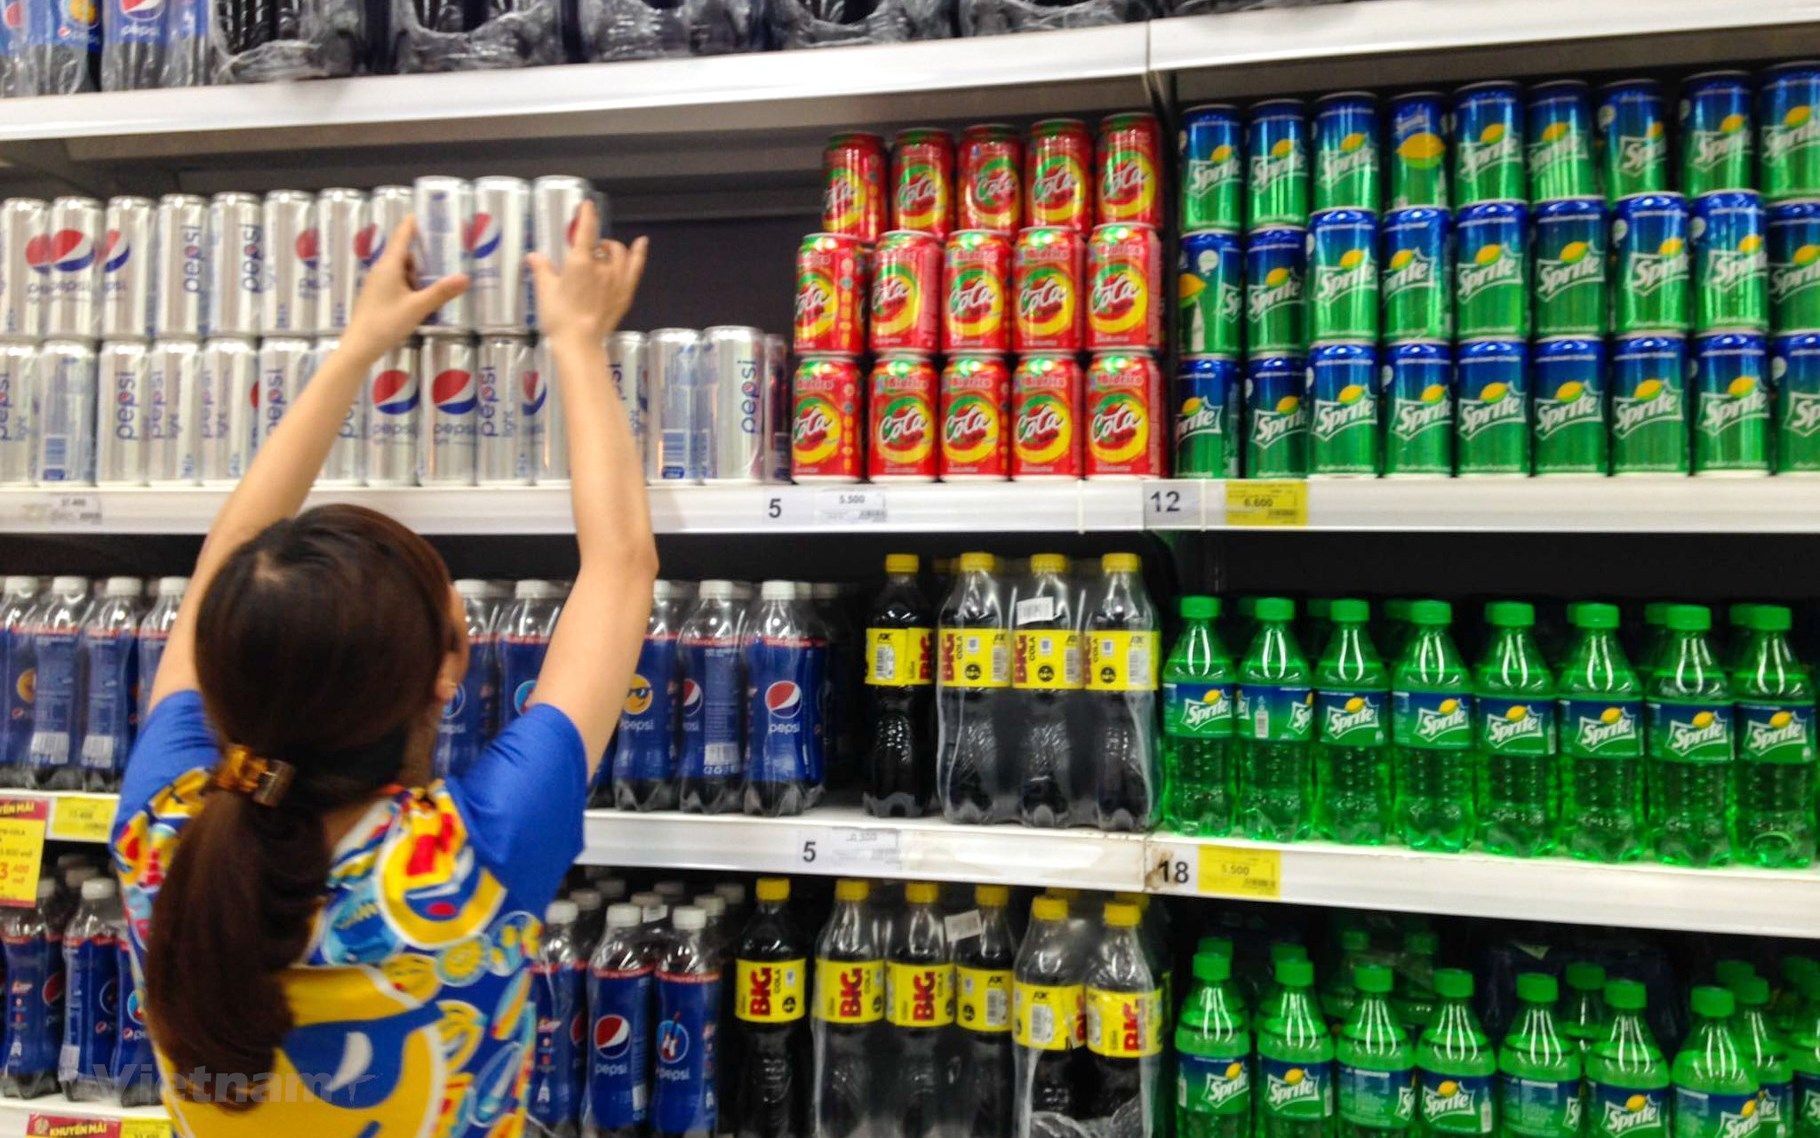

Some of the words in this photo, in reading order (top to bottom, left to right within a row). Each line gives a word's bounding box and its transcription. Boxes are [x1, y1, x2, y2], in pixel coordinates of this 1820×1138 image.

[1317, 264, 1374, 301] Sprite
[1457, 255, 1517, 297] Sprite
[1539, 254, 1601, 296] Sprite
[948, 278, 996, 318] Cola
[1020, 277, 1068, 318] Cola
[1090, 274, 1141, 314] Cola
[115, 371, 141, 440] pepsi
[479, 366, 498, 437] pepsi
[737, 360, 760, 434] pepsi
[1315, 397, 1375, 434] Sprite
[1459, 395, 1520, 434] Sprite
[1535, 394, 1595, 434] Sprite
[1613, 392, 1677, 432] Sprite
[1702, 390, 1767, 432] Sprite
[879, 404, 929, 444] Cola
[944, 403, 992, 443] Cola
[1016, 402, 1064, 444] Cola
[1091, 400, 1141, 443] Cola
[768, 498, 782, 519] 5
[1150, 490, 1181, 512] 12
[622, 719, 654, 732] pepsi
[768, 723, 800, 735] pepsi
[1187, 699, 1229, 726] Sprite
[1329, 707, 1375, 734] Sprite
[1419, 710, 1466, 737] Sprite
[1488, 715, 1538, 743] Sprite
[1581, 719, 1632, 746] Sprite
[1671, 721, 1724, 750] Sprite
[1749, 723, 1802, 750] Sprite
[803, 840, 816, 863] 5
[1158, 860, 1189, 884] 18
[750, 967, 773, 1016] BIG
[840, 967, 863, 1017] BIG
[913, 971, 935, 1021] BIG
[595, 1063, 628, 1077] pepsi
[659, 1067, 691, 1082] pepsi
[1269, 1076, 1314, 1103] Sprite
[1425, 1091, 1469, 1117] Sprite
[1607, 1103, 1657, 1133] Sprite
